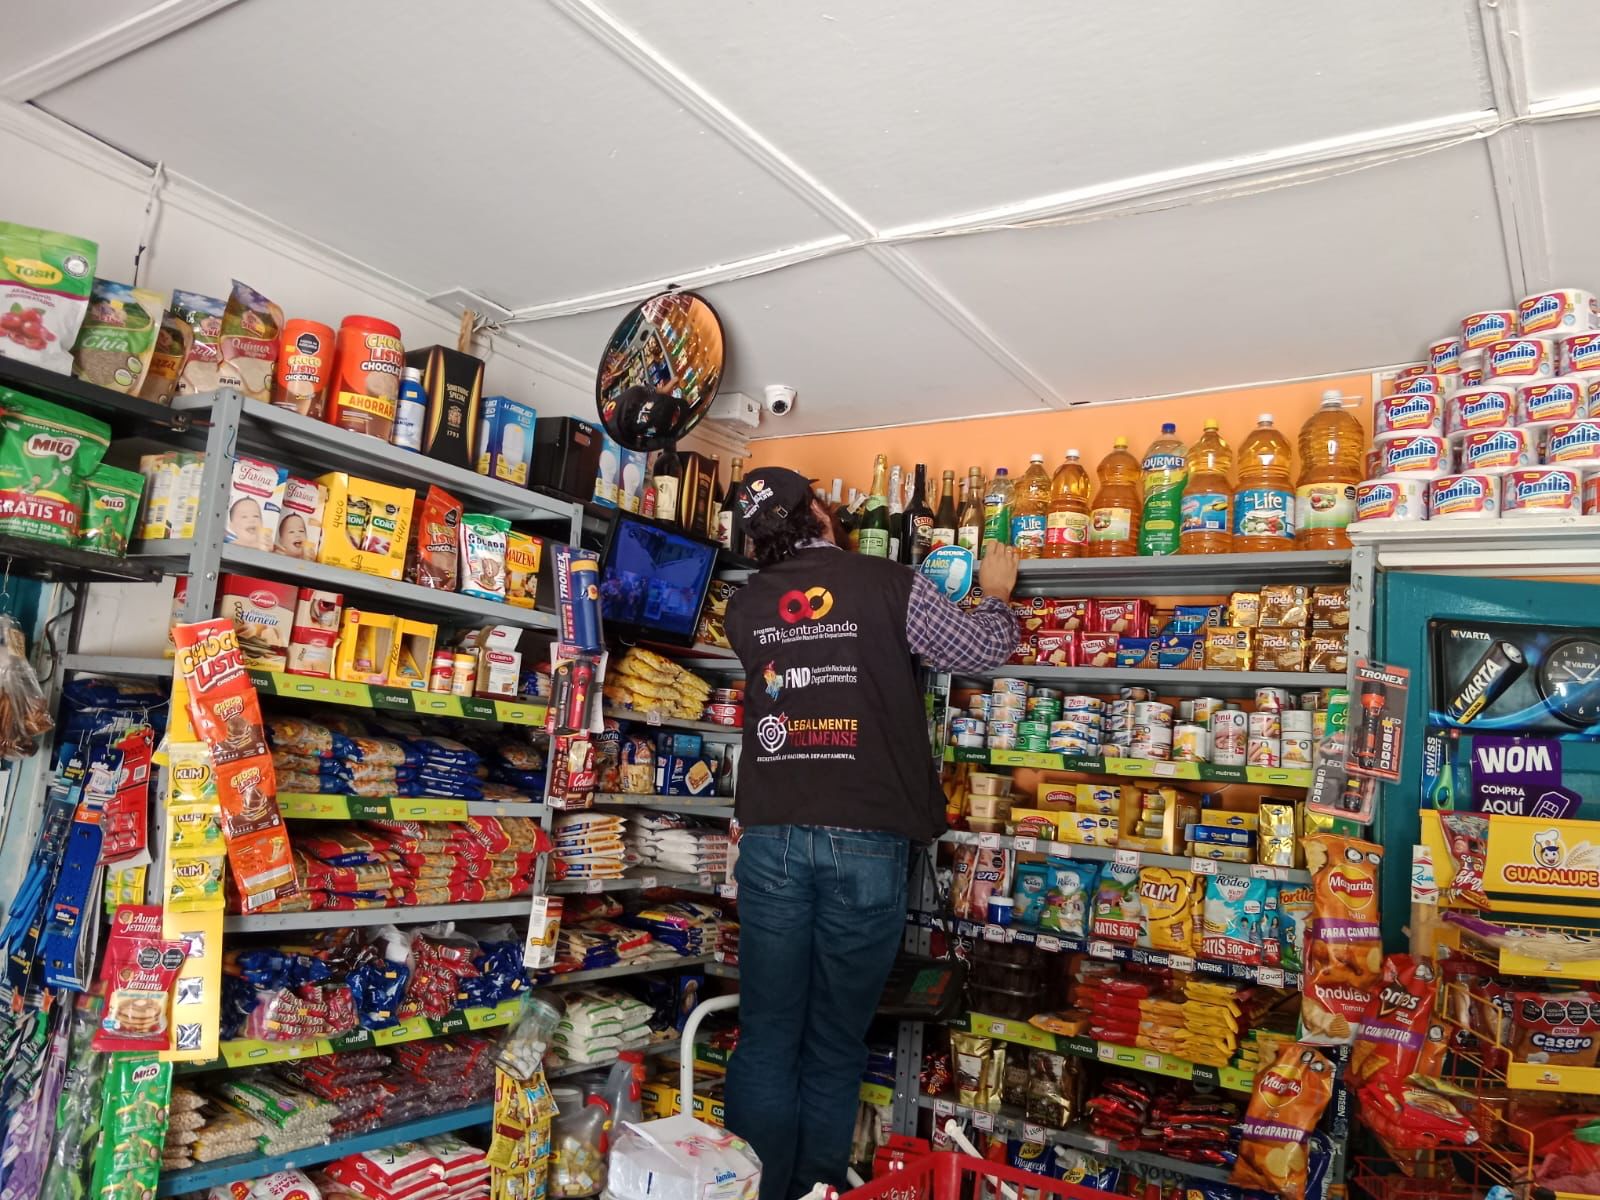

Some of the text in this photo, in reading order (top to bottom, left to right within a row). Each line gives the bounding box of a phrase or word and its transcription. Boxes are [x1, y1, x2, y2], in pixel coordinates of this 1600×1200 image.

[15, 264, 56, 280] TOSH
[1522, 300, 1559, 322] familia
[1465, 318, 1506, 337] familia
[230, 338, 272, 354] Quinua
[1573, 342, 1600, 361] fami
[1434, 346, 1459, 365] famil
[1494, 347, 1537, 364] familia
[288, 365, 318, 375] LISTO
[284, 373, 321, 384] CHOCOLATE
[449, 390, 466, 402] SPECIAL
[1529, 390, 1574, 408] familia
[1389, 402, 1430, 418] familia
[1463, 399, 1506, 416] familia
[32, 439, 73, 457] MILO
[1389, 444, 1437, 462] familia
[1469, 440, 1518, 457] familia
[1435, 485, 1482, 504] familia
[1518, 479, 1571, 497] familia
[1254, 492, 1283, 511] Life
[1022, 518, 1042, 531] Life
[557, 552, 568, 599] TRONEX
[1267, 595, 1292, 604] noel
[1318, 597, 1342, 607] noel
[240, 610, 279, 627] Hornear
[759, 620, 858, 645] anticontrabando
[1459, 630, 1491, 641] VARTA
[1211, 637, 1235, 646] noel
[1263, 638, 1287, 648] noel
[1316, 641, 1341, 651] noel
[1576, 646, 1584, 655] 12
[196, 653, 245, 685] LISTO
[1571, 661, 1597, 669] VARTA
[216, 669, 245, 687] CHOCOLATE
[252, 677, 268, 687] tresa
[785, 667, 811, 688] FND
[811, 673, 857, 685] Departamentos
[1360, 668, 1405, 685] TRONEX
[1461, 658, 1502, 705] VARTA
[385, 695, 409, 705] nutresa
[1579, 706, 1584, 715] 6
[787, 718, 858, 731] LEGALMENTE
[788, 731, 857, 747] TOLIMENSE
[810, 753, 856, 761] DEPARTAMENTAL
[966, 752, 986, 761] nutresa
[1321, 758, 1342, 768] LED
[1426, 736, 1437, 777] swiss
[1477, 745, 1553, 774] WOM
[1078, 760, 1101, 768] nutresa
[176, 767, 204, 779] KLIM
[1216, 769, 1241, 778] nutresa
[1480, 784, 1526, 796] COMPRA
[364, 804, 379, 814] nutr
[1481, 799, 1525, 816] AQUÍ
[176, 864, 203, 876] KLIM
[1109, 863, 1138, 875] Rodeo
[977, 871, 1000, 882] ena
[1215, 875, 1251, 889] Rodeo
[1329, 874, 1375, 893] Margarita
[1504, 866, 1599, 887] GUADALUPE
[1140, 881, 1178, 902] KLIM
[133, 912, 159, 924] Aunt
[120, 922, 162, 934] Jemima
[1094, 921, 1135, 938] RATIS 600
[1320, 926, 1380, 939] PARA COMPAR
[1203, 937, 1226, 954] ATIS
[1227, 942, 1243, 955] 500
[1148, 955, 1169, 966] Nestl
[133, 971, 160, 982] Aunt
[122, 978, 162, 991] Jemima
[1379, 987, 1420, 1009] oritos
[1340, 1003, 1365, 1013] Tomate
[1364, 1024, 1412, 1043] COMPARTIR
[1070, 1042, 1093, 1054] nutresa
[1532, 1033, 1592, 1049] Casero
[133, 1067, 159, 1081] MILO
[1193, 1069, 1213, 1080] utresa
[1253, 1124, 1304, 1141] COMPARTIR
[716, 1169, 737, 1184] familia
